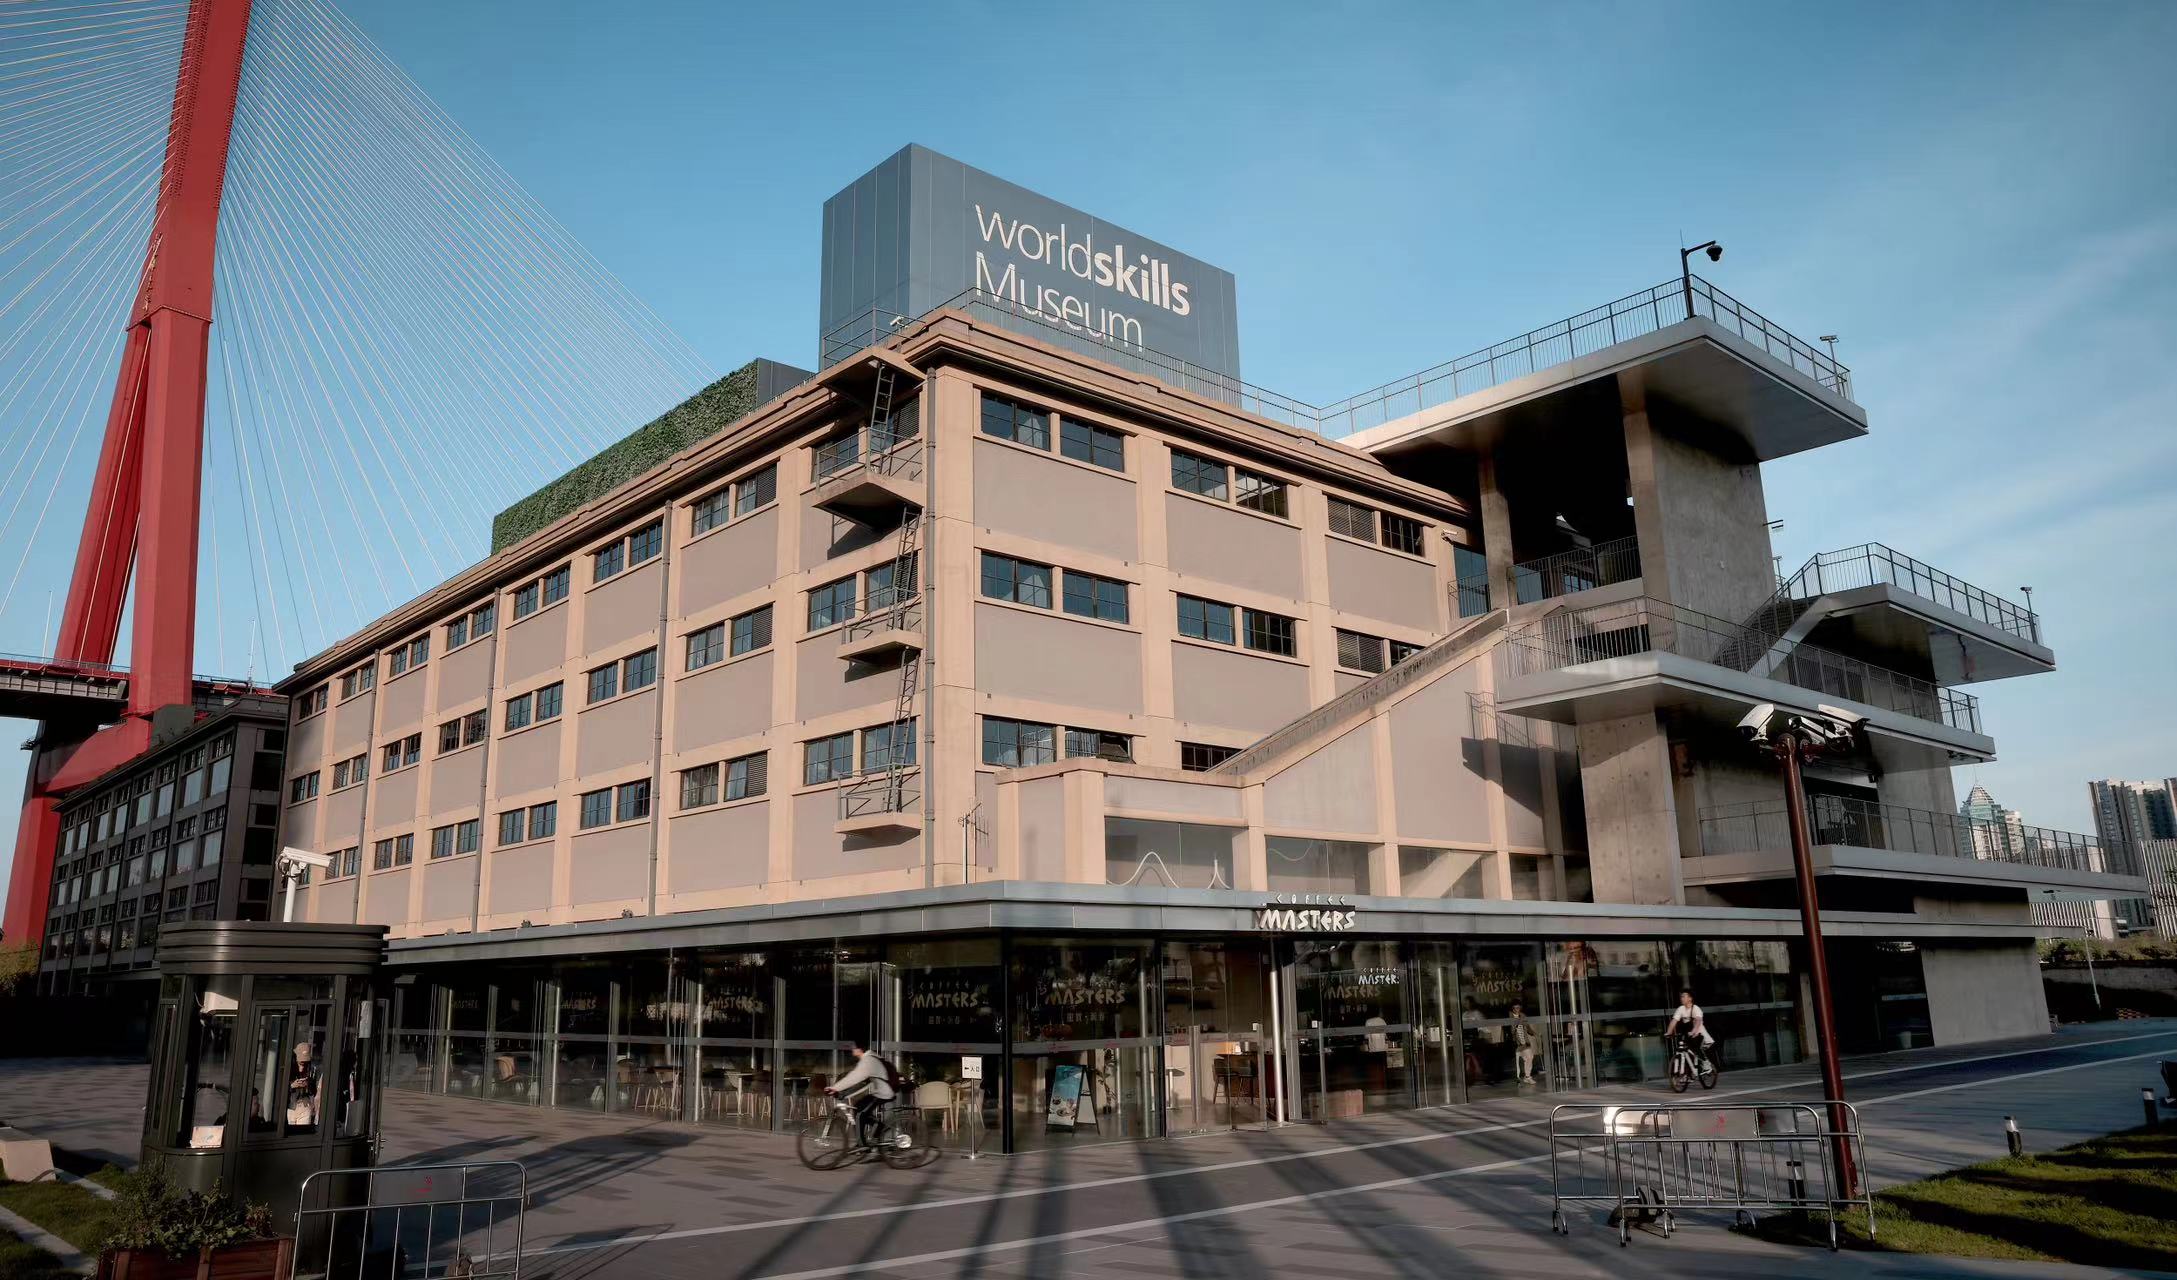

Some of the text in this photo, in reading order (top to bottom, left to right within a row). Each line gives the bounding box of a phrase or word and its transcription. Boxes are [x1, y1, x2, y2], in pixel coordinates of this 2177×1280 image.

[975, 204, 1190, 316] worldskills
[976, 251, 1143, 352] Museum
[1277, 894, 1346, 906] COFFEE
[1259, 909, 1356, 932] MASTERS
[912, 991, 978, 1009] MASTERS
[1044, 988, 1126, 1006] MASTERS
